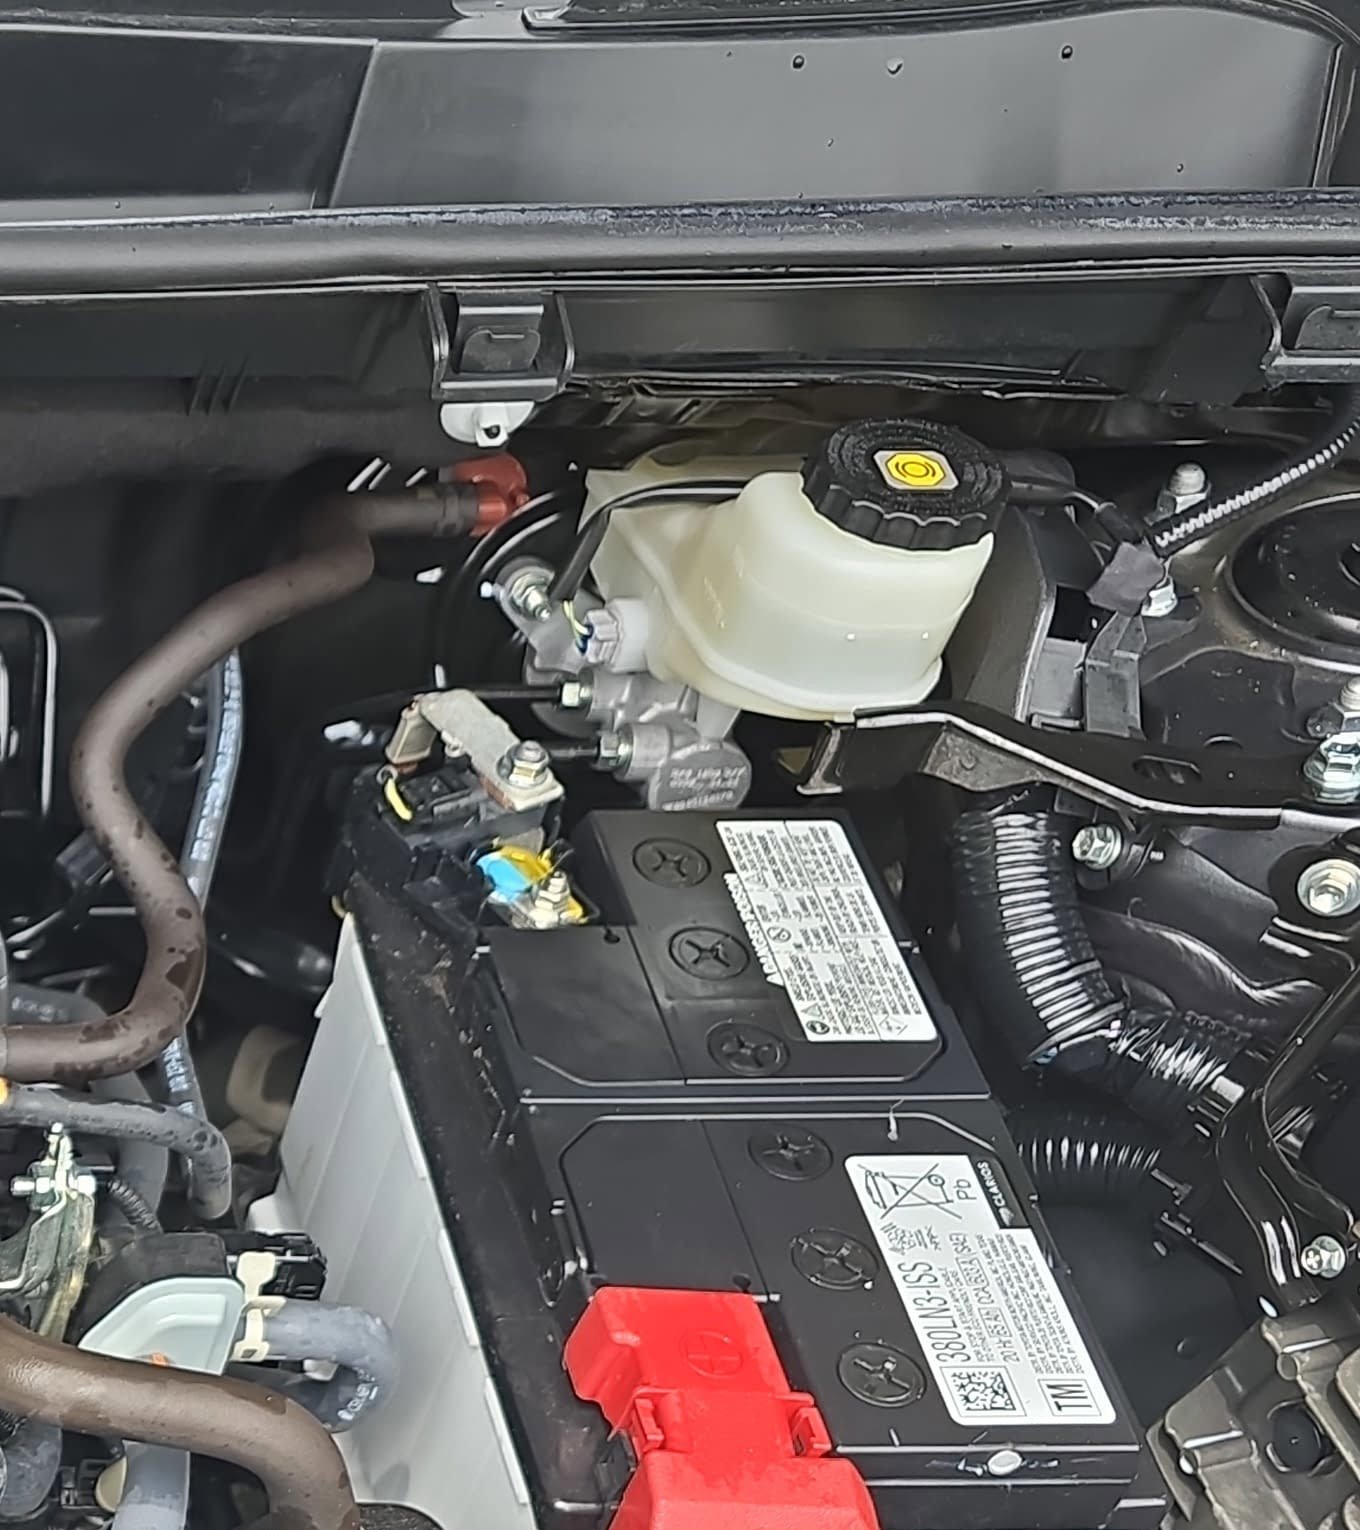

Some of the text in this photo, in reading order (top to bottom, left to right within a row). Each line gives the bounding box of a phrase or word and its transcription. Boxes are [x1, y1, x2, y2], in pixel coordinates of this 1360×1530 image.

[949, 1178, 978, 1200] Pb
[976, 1161, 1007, 1206] CLARIOS
[895, 1261, 972, 1361] 380LN3-ISS
[1045, 1383, 1094, 1411] TM
